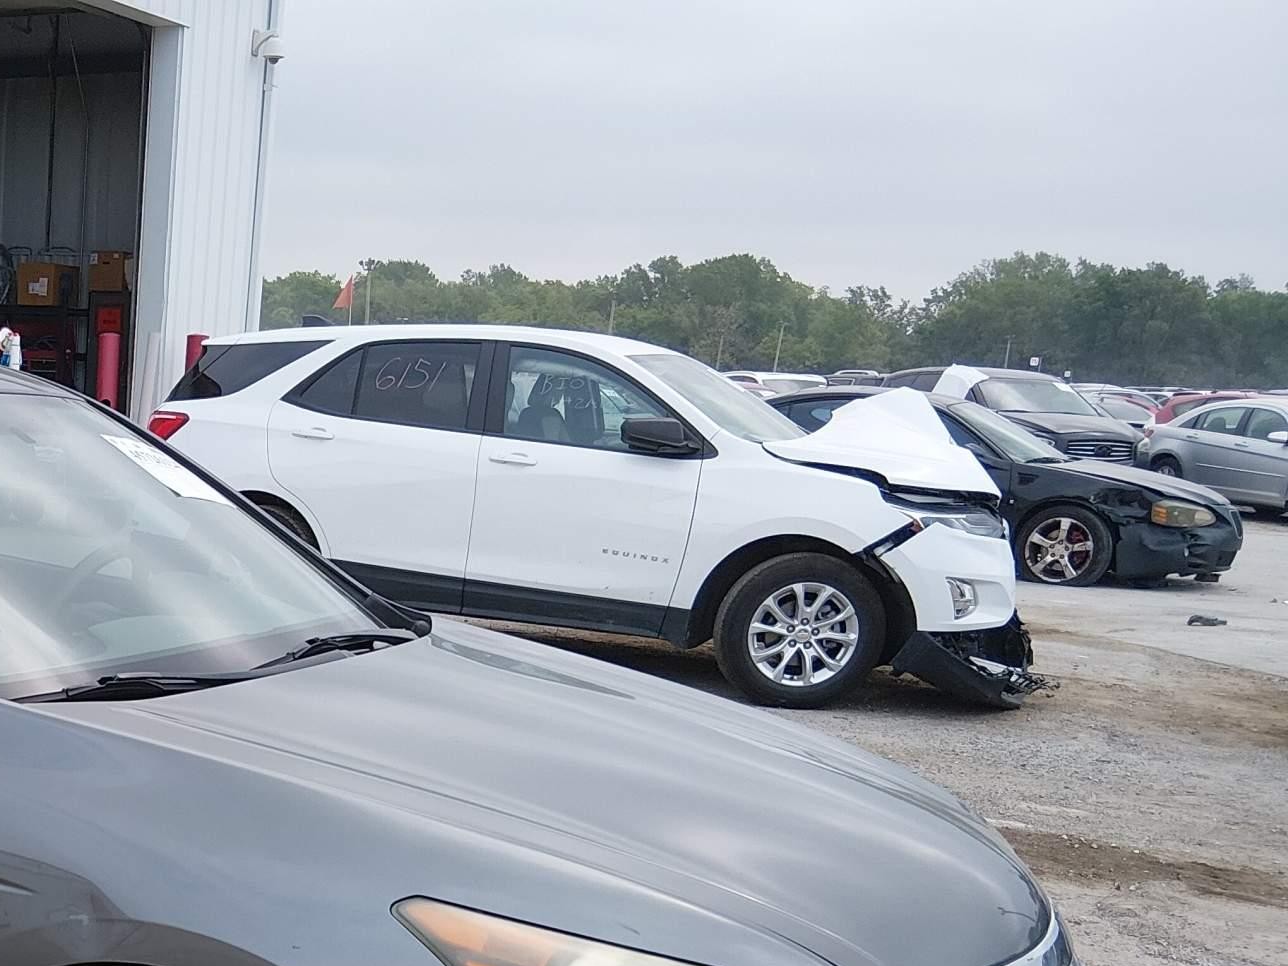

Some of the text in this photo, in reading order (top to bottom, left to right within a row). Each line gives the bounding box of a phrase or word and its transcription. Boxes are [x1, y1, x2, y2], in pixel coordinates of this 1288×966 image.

[375, 357, 448, 392] 6151
[540, 374, 585, 395] BIO
[601, 548, 670, 564] EQUINOX
